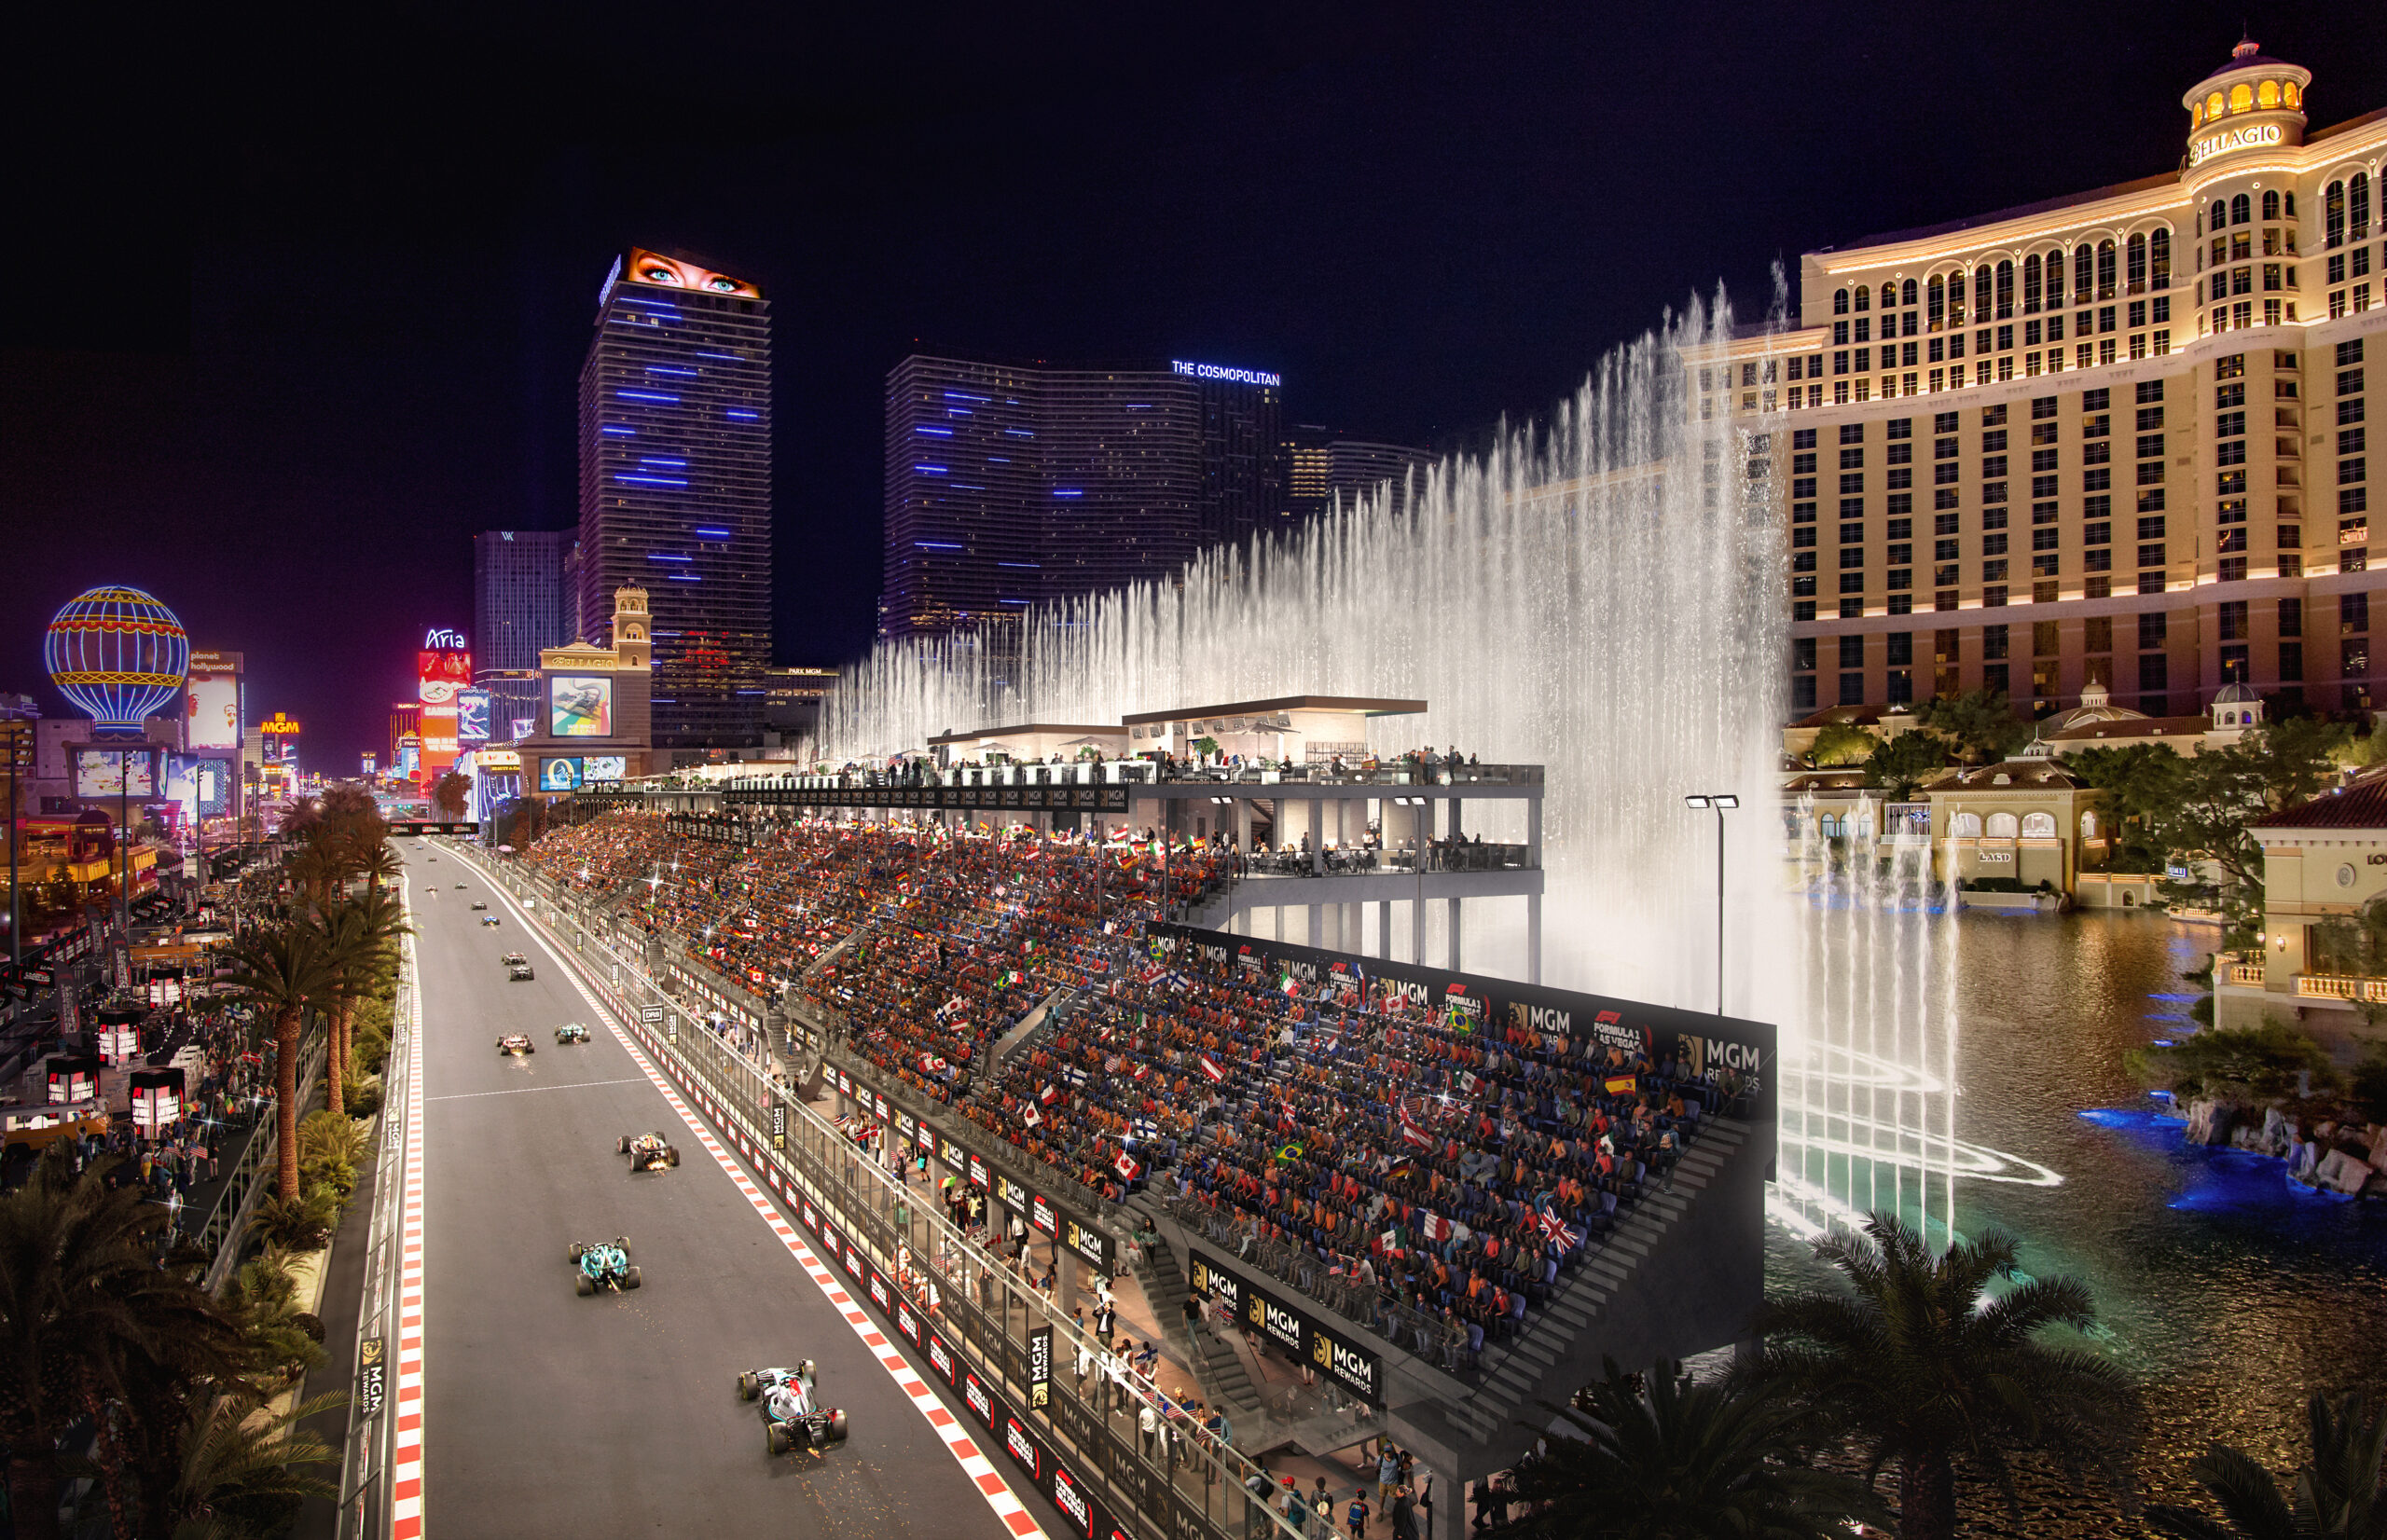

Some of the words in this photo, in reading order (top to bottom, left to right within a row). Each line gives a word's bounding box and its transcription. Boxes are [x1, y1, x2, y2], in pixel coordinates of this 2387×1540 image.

[2189, 125, 2283, 165] BELLAGIO
[1172, 360, 1194, 375] THE
[1197, 364, 1280, 386] COSMOPOLITAN
[425, 628, 465, 649] Aria
[190, 652, 219, 661] planet
[190, 663, 234, 672] hollywood
[552, 656, 614, 668] BELLAGIO
[261, 722, 299, 734] MGM
[1028, 791, 1042, 800] MGM
[1053, 791, 1068, 800] MGM
[1080, 791, 1095, 800] MGM
[1108, 790, 1125, 801] MGM
[2366, 854, 2387, 866] LO
[1157, 936, 1176, 954] MGM
[1206, 944, 1227, 964] MGM
[1291, 960, 1317, 983] MGM
[1397, 981, 1428, 1005] MGM
[1445, 994, 1477, 1007] FORMULA
[1476, 1000, 1482, 1010] 1
[1530, 1005, 1570, 1034] MGM
[1594, 1022, 1633, 1038] FORMULA
[1635, 1029, 1641, 1040] 1
[1610, 1036, 1640, 1048] VEGAS
[1707, 1038, 1759, 1072] MGM
[901, 1112, 914, 1131] MGM
[392, 1122, 400, 1149] MGM
[949, 1143, 964, 1163] MGM
[1007, 1181, 1025, 1204] MGM
[1080, 1227, 1102, 1255] MGM
[1208, 1269, 1237, 1300] MGM
[1266, 1303, 1300, 1339] MGM
[1032, 1336, 1042, 1382] MGM
[1334, 1342, 1372, 1382] MGM
[370, 1366, 382, 1412] MGM
[1116, 1452, 1147, 1496] MGM
[1056, 1474, 1083, 1506] FORMULA
[1056, 1489, 1074, 1514] GRAND
[1073, 1509, 1088, 1529] PRIX
[1066, 1492, 1085, 1518] VEGAS
